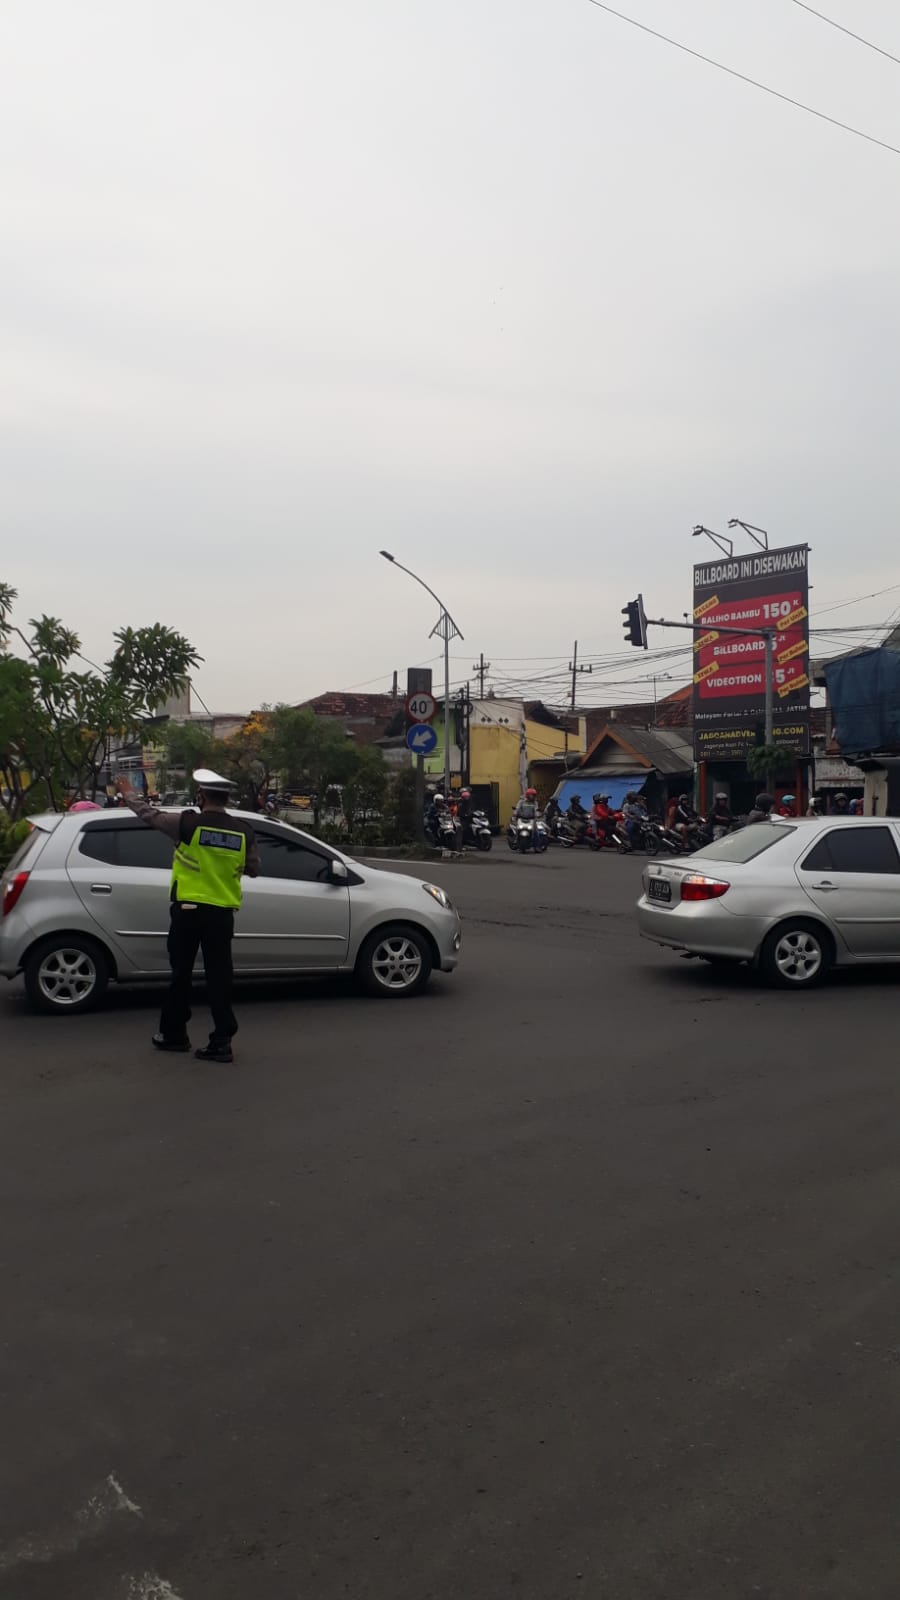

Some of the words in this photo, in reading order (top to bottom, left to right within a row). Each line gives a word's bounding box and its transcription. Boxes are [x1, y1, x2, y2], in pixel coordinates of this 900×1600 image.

[695, 563, 739, 586] BILLBOARD
[740, 560, 752, 577] INI
[754, 549, 806, 575] DISEWAKAN
[701, 614, 730, 625] BALIHO
[731, 608, 760, 620] BAMBU
[762, 601, 791, 619] 150
[706, 674, 762, 688] VIDEOTRON
[410, 700, 427, 714] 40
